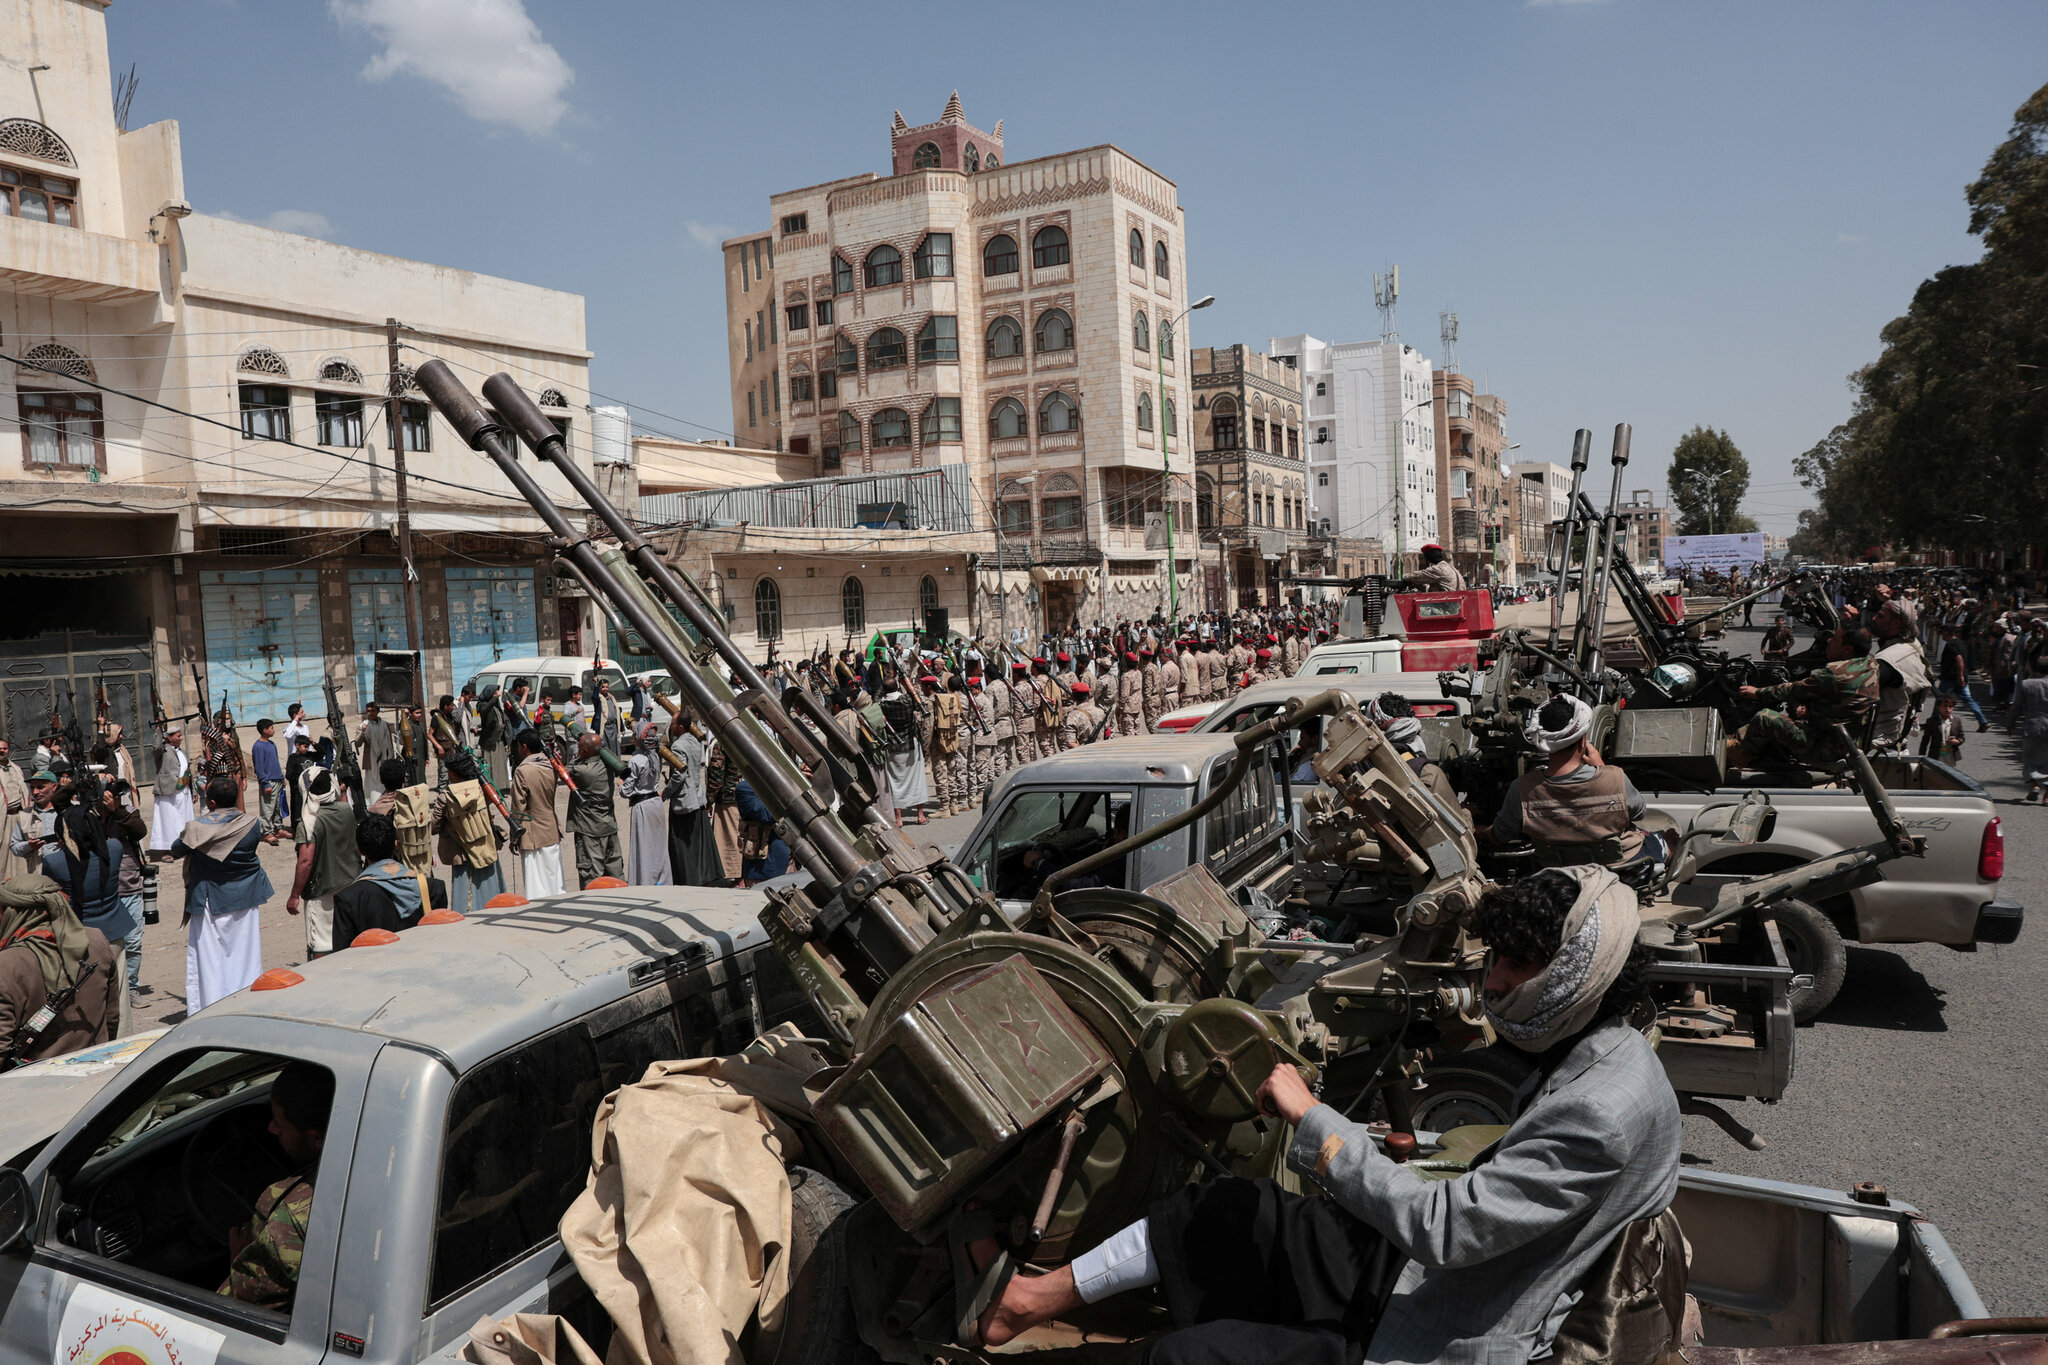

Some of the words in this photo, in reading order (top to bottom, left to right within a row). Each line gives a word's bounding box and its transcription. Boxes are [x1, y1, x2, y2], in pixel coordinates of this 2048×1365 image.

[67, 1313, 107, 1362] المركزية
[111, 1309, 168, 1341] العسكرية
[335, 1337, 362, 1352] SLT
